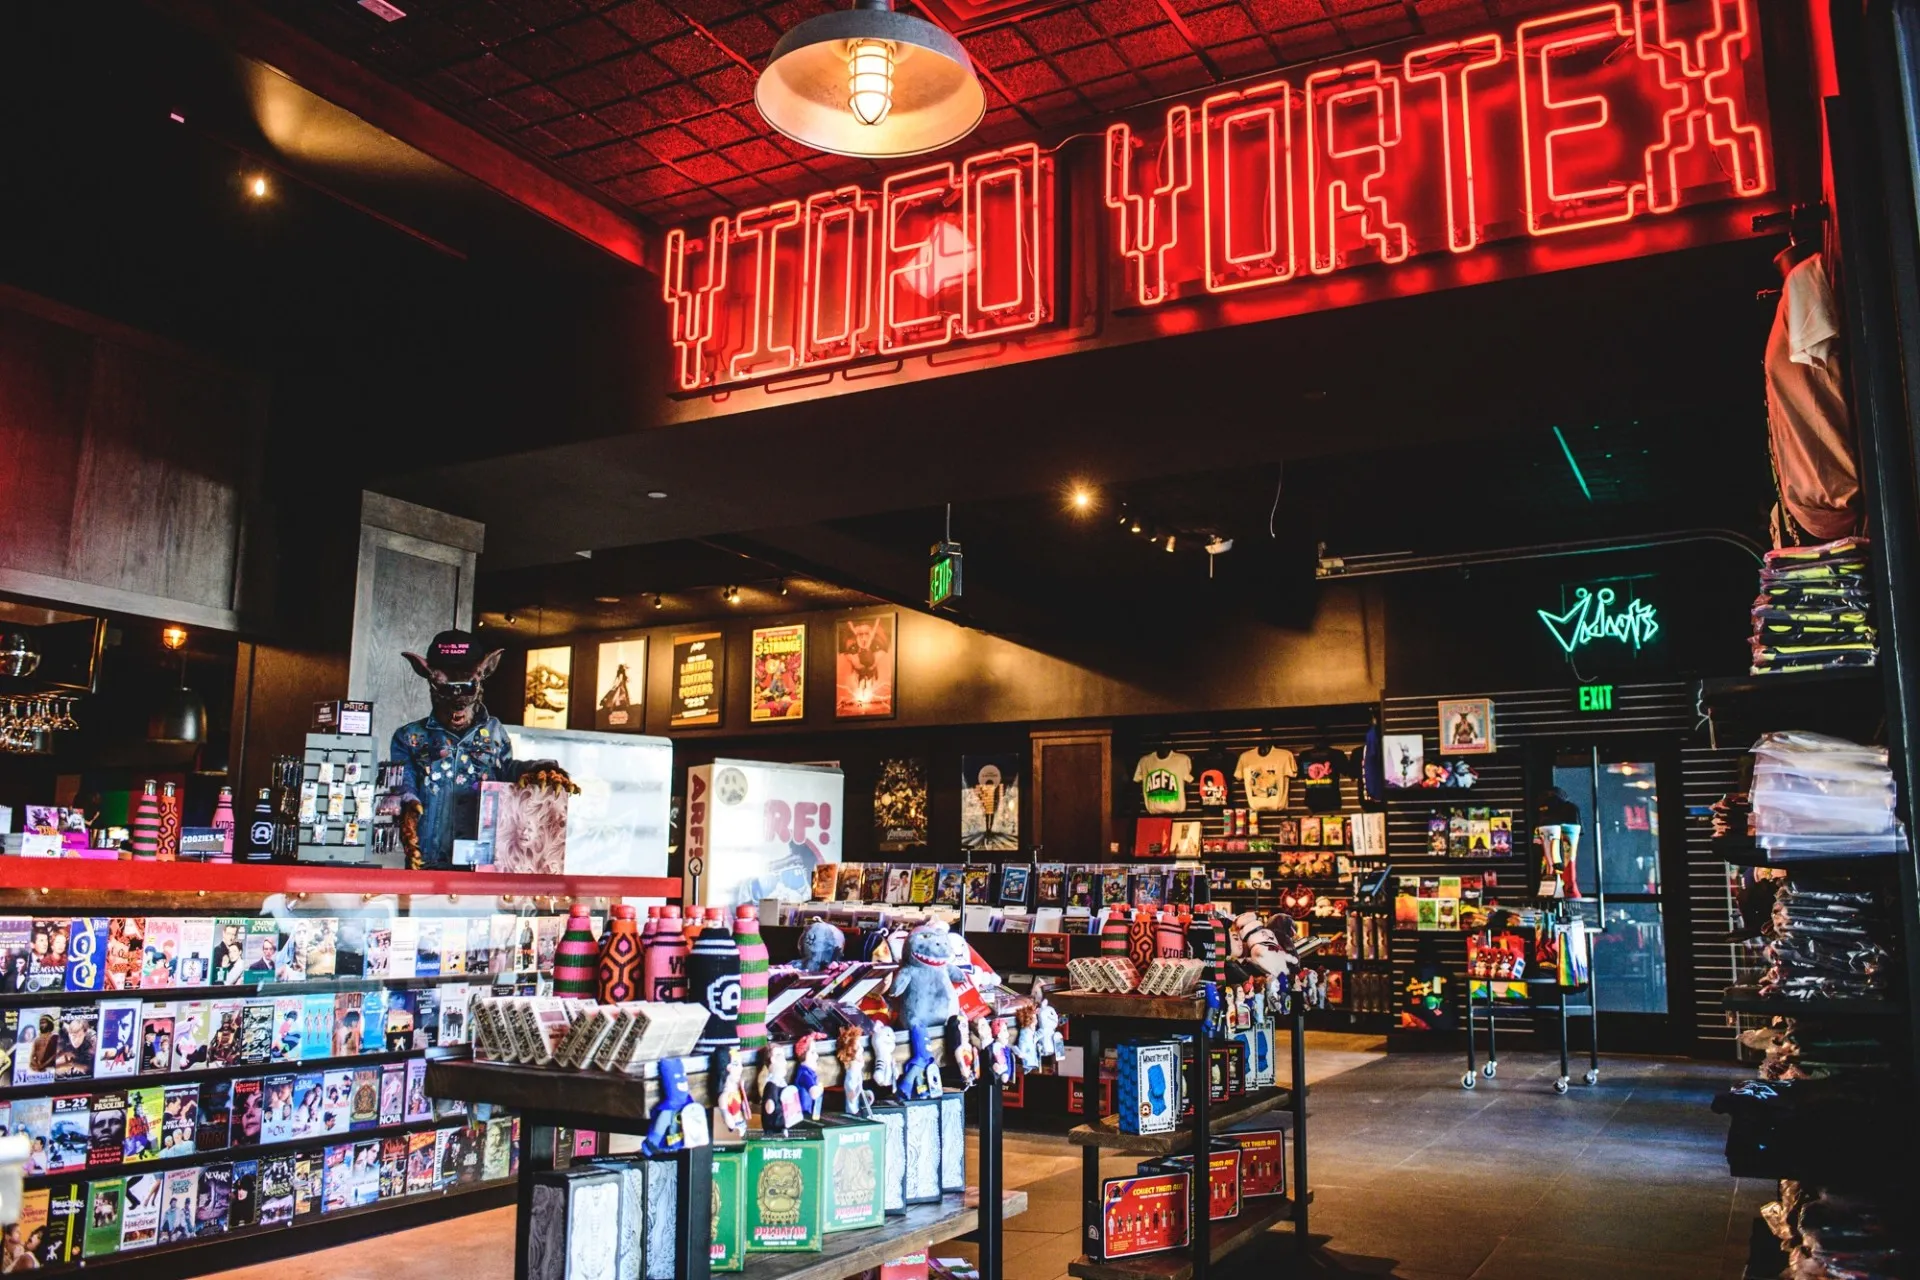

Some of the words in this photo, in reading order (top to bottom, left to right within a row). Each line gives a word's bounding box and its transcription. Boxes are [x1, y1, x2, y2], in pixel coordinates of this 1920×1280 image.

[664, 142, 1040, 390] VIDEO
[1106, 0, 1767, 304] VORTEX
[933, 558, 952, 602] EXIT
[680, 659, 714, 675] LIMITED
[1579, 685, 1613, 711] EXIT
[343, 703, 369, 711] PRIDE
[1146, 769, 1178, 792] AGFA
[764, 799, 831, 845] RF!
[182, 834, 214, 843] COOZIES
[55, 1097, 88, 1109] B-29
[379, 1114, 401, 1125] NOVA
[1132, 1186, 1155, 1196] COLLECT
[1155, 1184, 1172, 1193] THEM
[754, 1226, 807, 1240] PREDATOR
